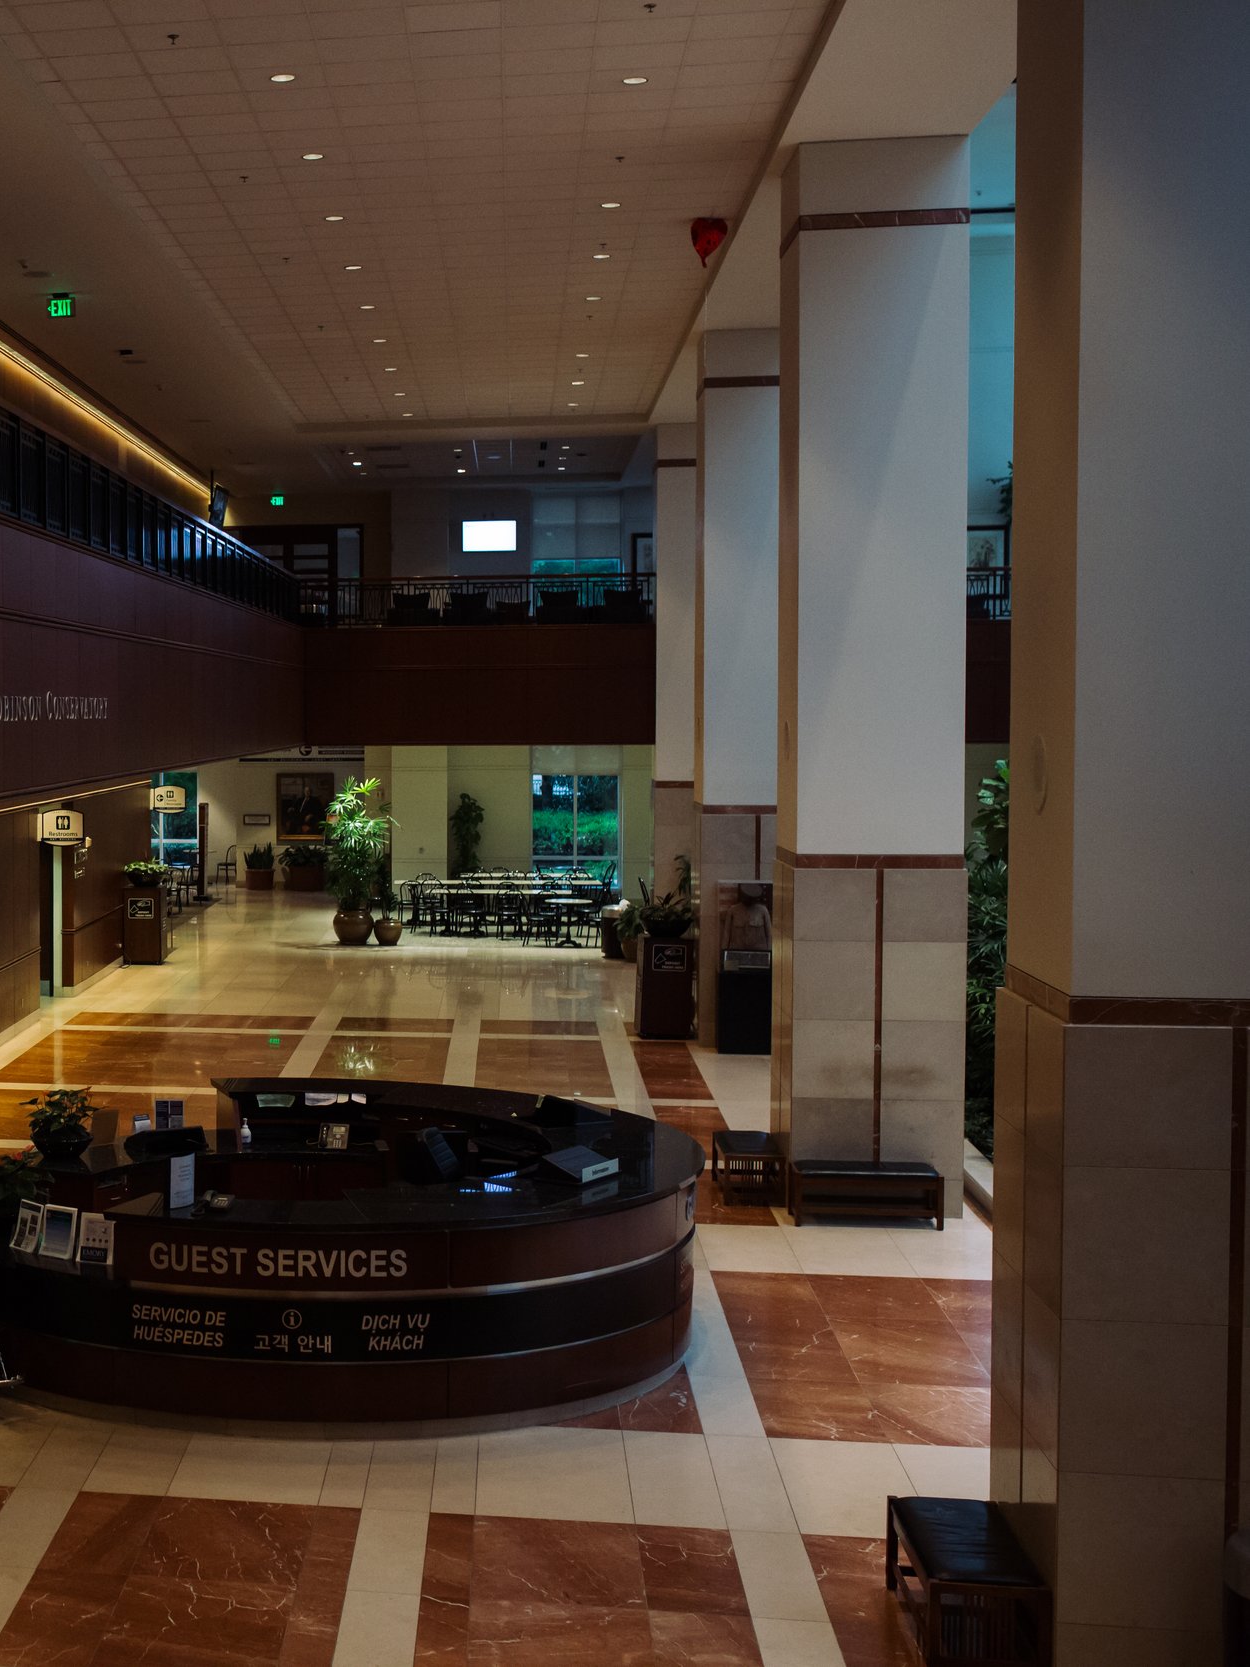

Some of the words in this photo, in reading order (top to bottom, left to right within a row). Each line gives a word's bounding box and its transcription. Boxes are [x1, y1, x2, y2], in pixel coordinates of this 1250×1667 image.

[51, 299, 71, 316] EXIT
[46, 690, 109, 720] CONSERVATORY
[149, 1242, 247, 1275] GUEST
[256, 1248, 408, 1278] SERVICES
[131, 1304, 201, 1326] SERVICIO
[204, 1309, 227, 1327] DE
[361, 1313, 400, 1333] DỊCH
[407, 1313, 430, 1332] VỤ
[133, 1321, 225, 1347] HUÉSPEDES
[254, 1334, 289, 1353] 고객
[297, 1334, 332, 1353] 안내
[367, 1334, 424, 1351] KHÁCH
